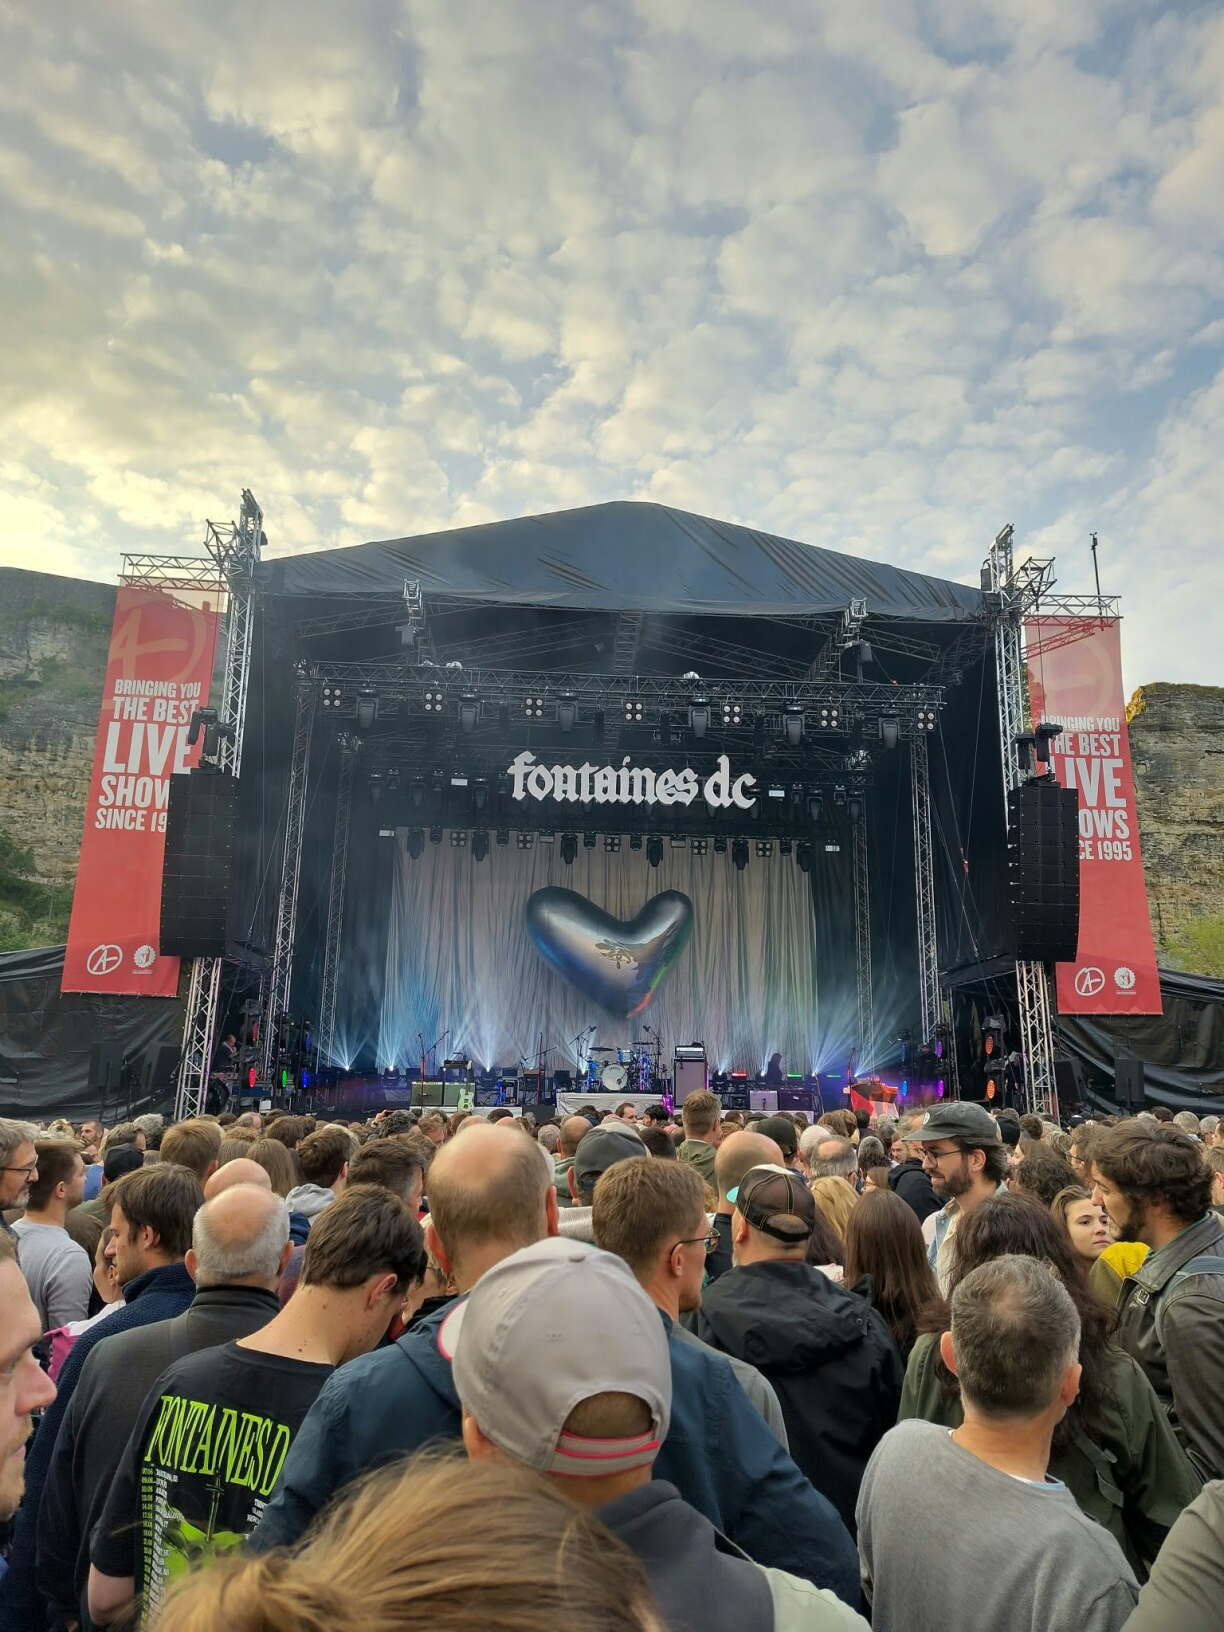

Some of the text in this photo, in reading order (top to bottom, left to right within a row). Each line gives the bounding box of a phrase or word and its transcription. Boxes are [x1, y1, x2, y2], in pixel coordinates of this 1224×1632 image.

[114, 679, 201, 699] BRINGING YOU
[112, 696, 199, 724] THE BEST
[1096, 717, 1120, 732] YOU
[103, 721, 192, 776] LIVE
[1079, 733, 1121, 757] BEST
[99, 775, 171, 810] SHOW
[507, 750, 757, 809] fontaines dc
[1048, 756, 1127, 807] IVE
[95, 808, 148, 831] SINCE
[1078, 808, 1130, 839] OWS
[1097, 841, 1132, 861] 1995
